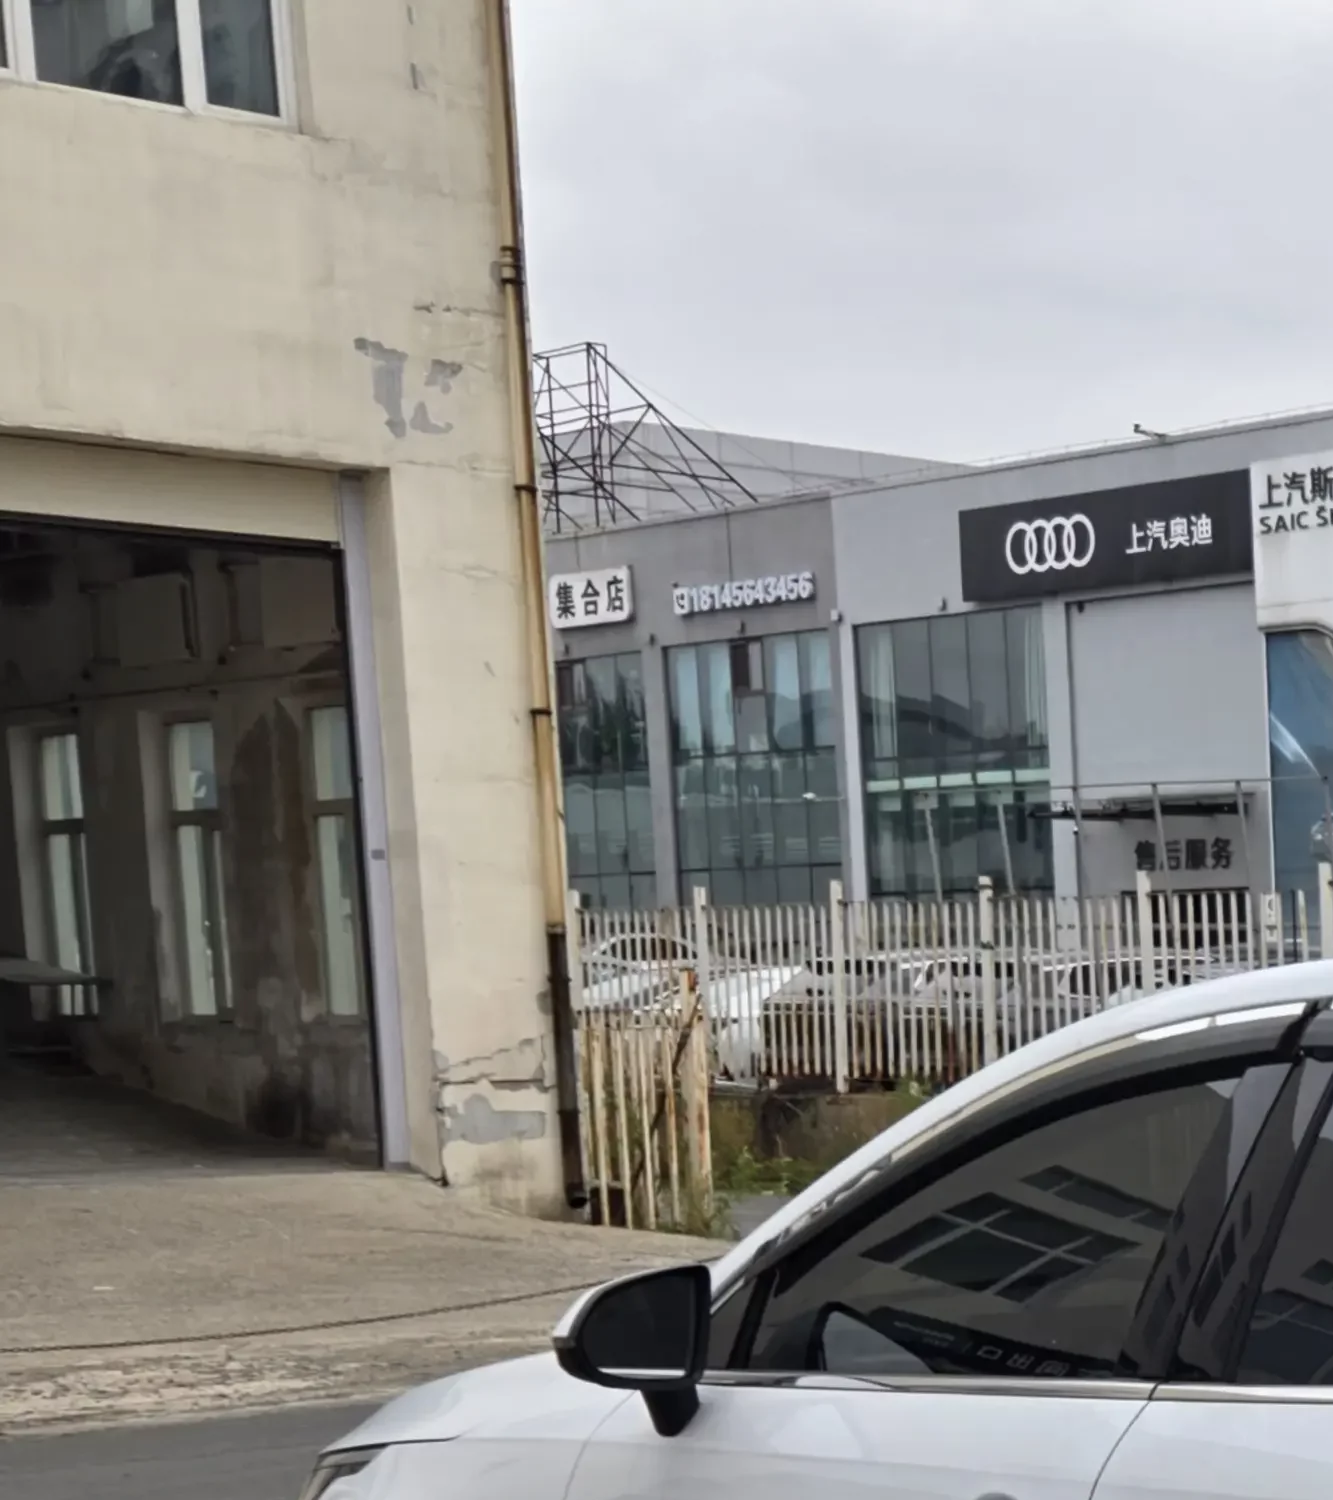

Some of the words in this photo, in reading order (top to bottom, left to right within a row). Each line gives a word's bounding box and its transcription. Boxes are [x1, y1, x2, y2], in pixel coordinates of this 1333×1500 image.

[1125, 512, 1213, 554] 上汽奥迪
[1259, 510, 1311, 534] SAIC
[555, 575, 625, 619] 集合店
[690, 571, 814, 613] 18145643456
[1134, 837, 1232, 872] 售后服务
